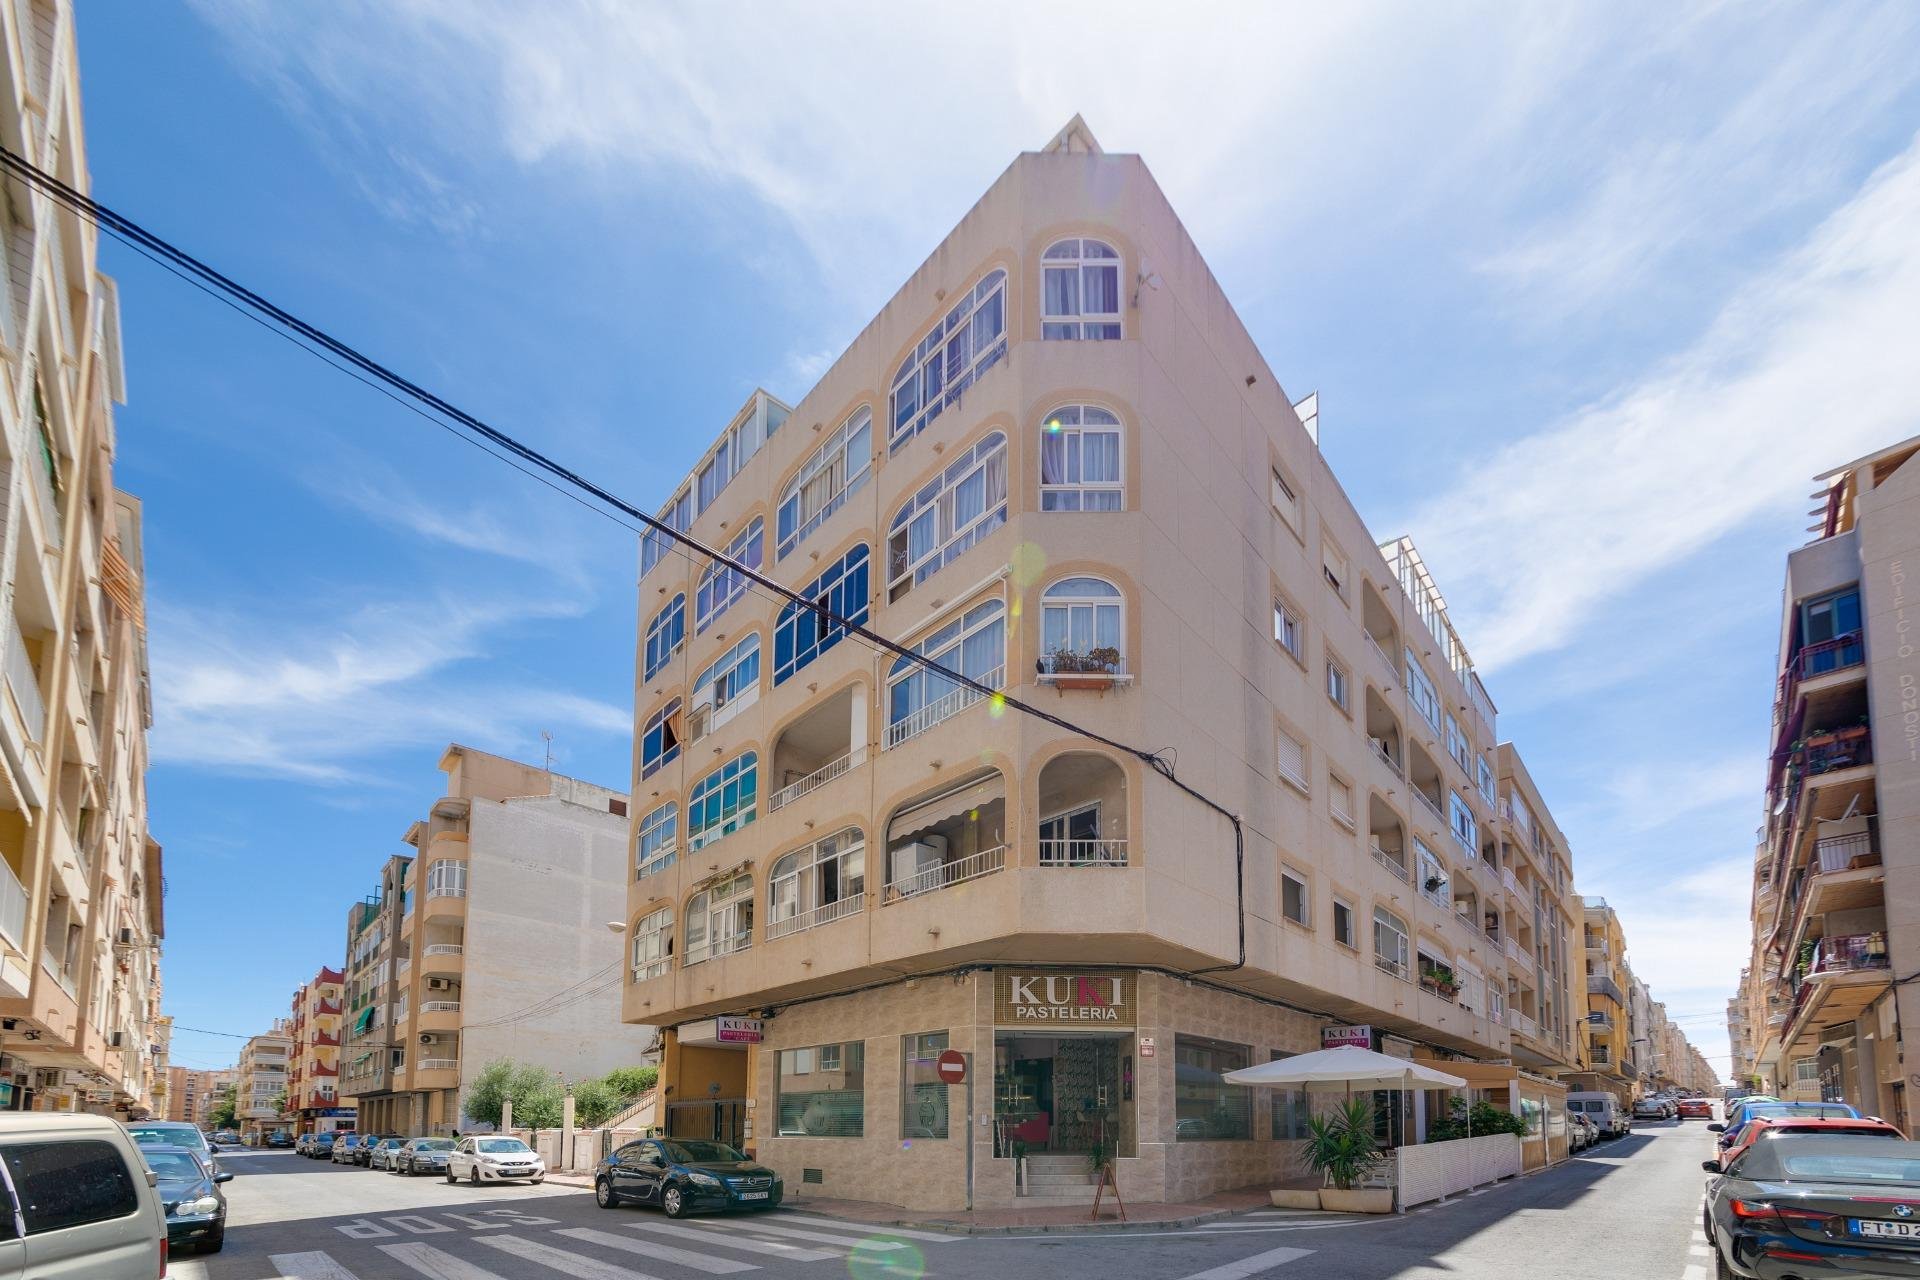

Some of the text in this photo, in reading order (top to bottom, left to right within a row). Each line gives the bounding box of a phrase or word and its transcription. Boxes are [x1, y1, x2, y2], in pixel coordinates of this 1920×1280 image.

[1890, 560, 1914, 658] EDIFICIO
[1008, 975, 1125, 1006] KUKI
[1016, 1006, 1118, 1020] PASTELERIA
[723, 1020, 758, 1030] KUKI
[1328, 1028, 1365, 1038] KUKI
[333, 1209, 562, 1240] STOP
